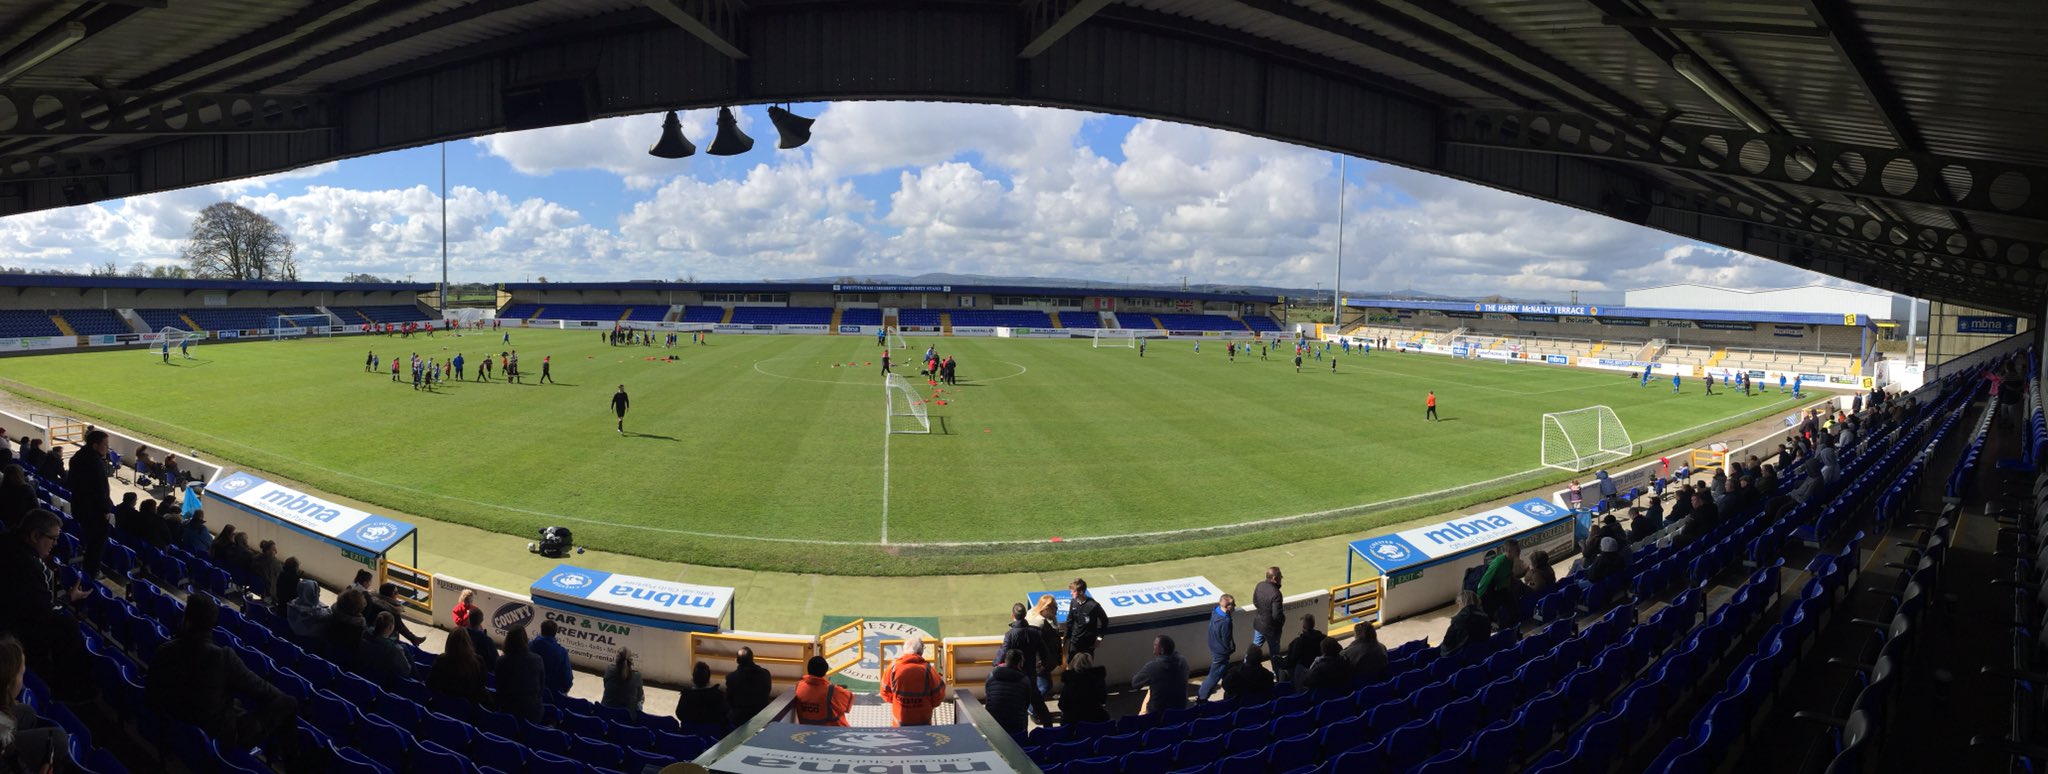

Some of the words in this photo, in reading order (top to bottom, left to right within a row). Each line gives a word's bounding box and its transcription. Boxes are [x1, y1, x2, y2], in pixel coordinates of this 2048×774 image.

[1498, 304, 1519, 312] HARRY
[1522, 305, 1551, 313] McNALLY
[1554, 306, 1585, 314] TERRACE
[1971, 319, 2002, 328] mbna
[221, 330, 237, 338] mbna
[1549, 355, 1565, 364] mbna
[260, 489, 341, 523] mbna
[1424, 514, 1513, 544] mbna
[351, 552, 365, 562] EXIT
[1398, 573, 1415, 583] EXIT
[608, 584, 716, 608] mbna
[1110, 586, 1213, 607] mbna
[494, 604, 532, 628] COUNTY
[545, 611, 577, 626] CAR
[580, 619, 592, 628] &
[598, 622, 631, 636] VAN
[557, 626, 617, 646] RENTAL
[566, 638, 585, 648] Trucks
[764, 752, 841, 763] Partner
[900, 757, 972, 765] Official
[741, 755, 992, 774] mbna
